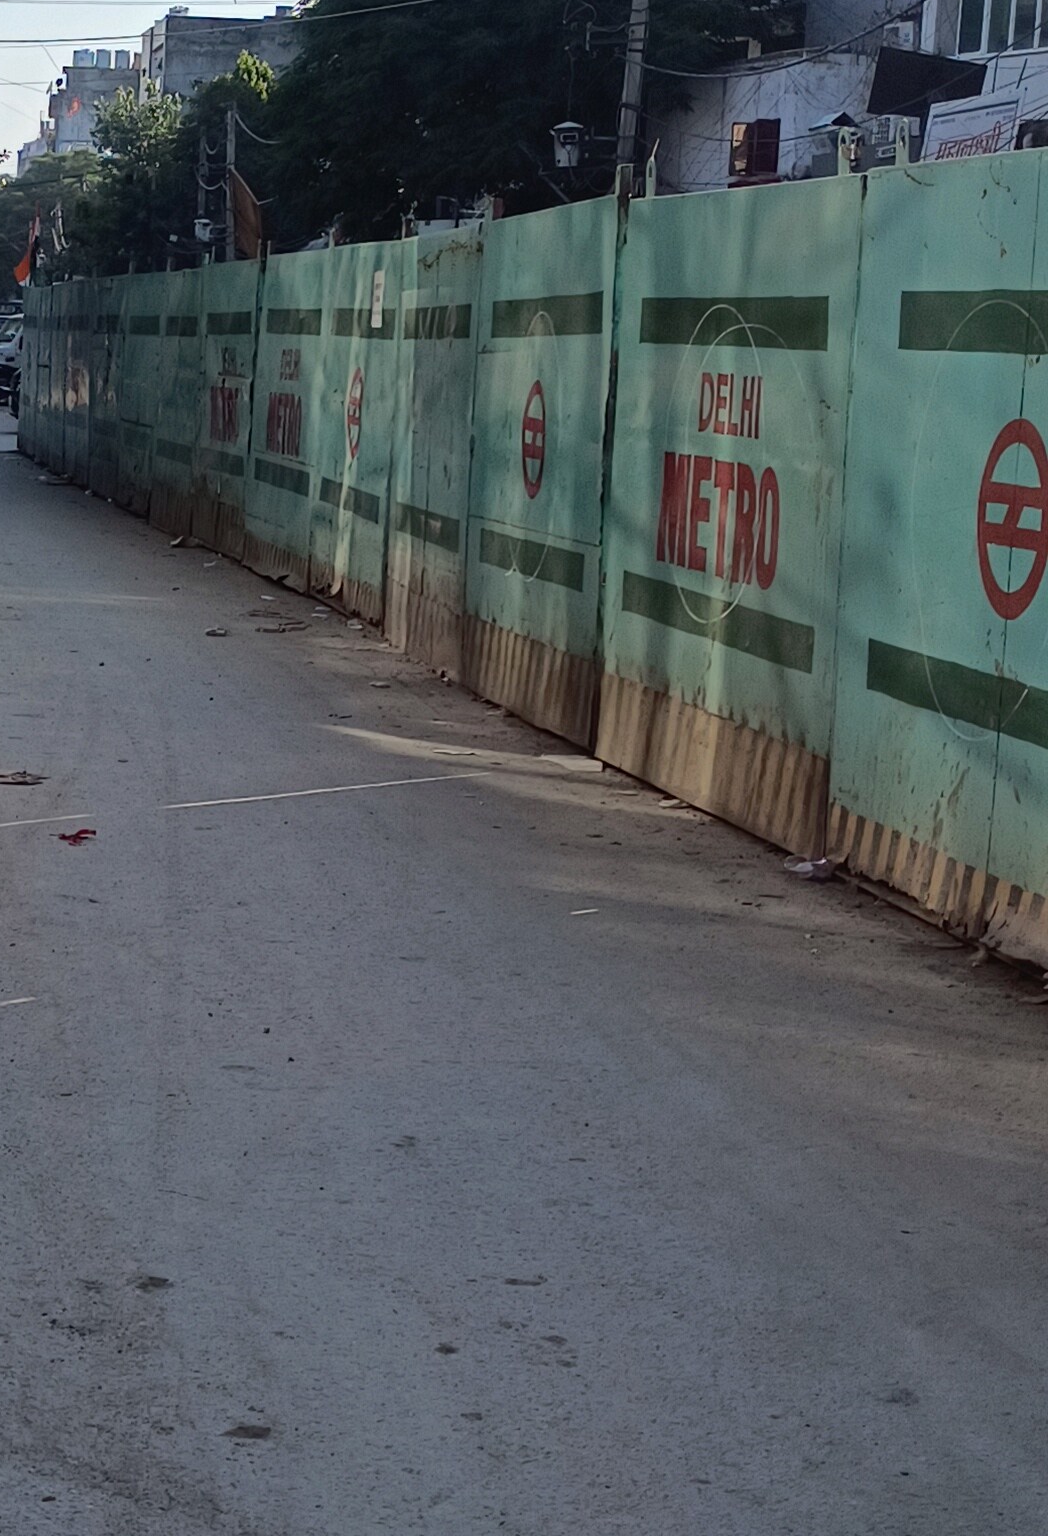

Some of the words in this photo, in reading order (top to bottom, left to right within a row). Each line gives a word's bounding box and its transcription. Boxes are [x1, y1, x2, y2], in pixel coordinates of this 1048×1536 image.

[267, 392, 302, 458] METRO
[698, 372, 762, 439] DELHI
[656, 451, 780, 590] METRO
